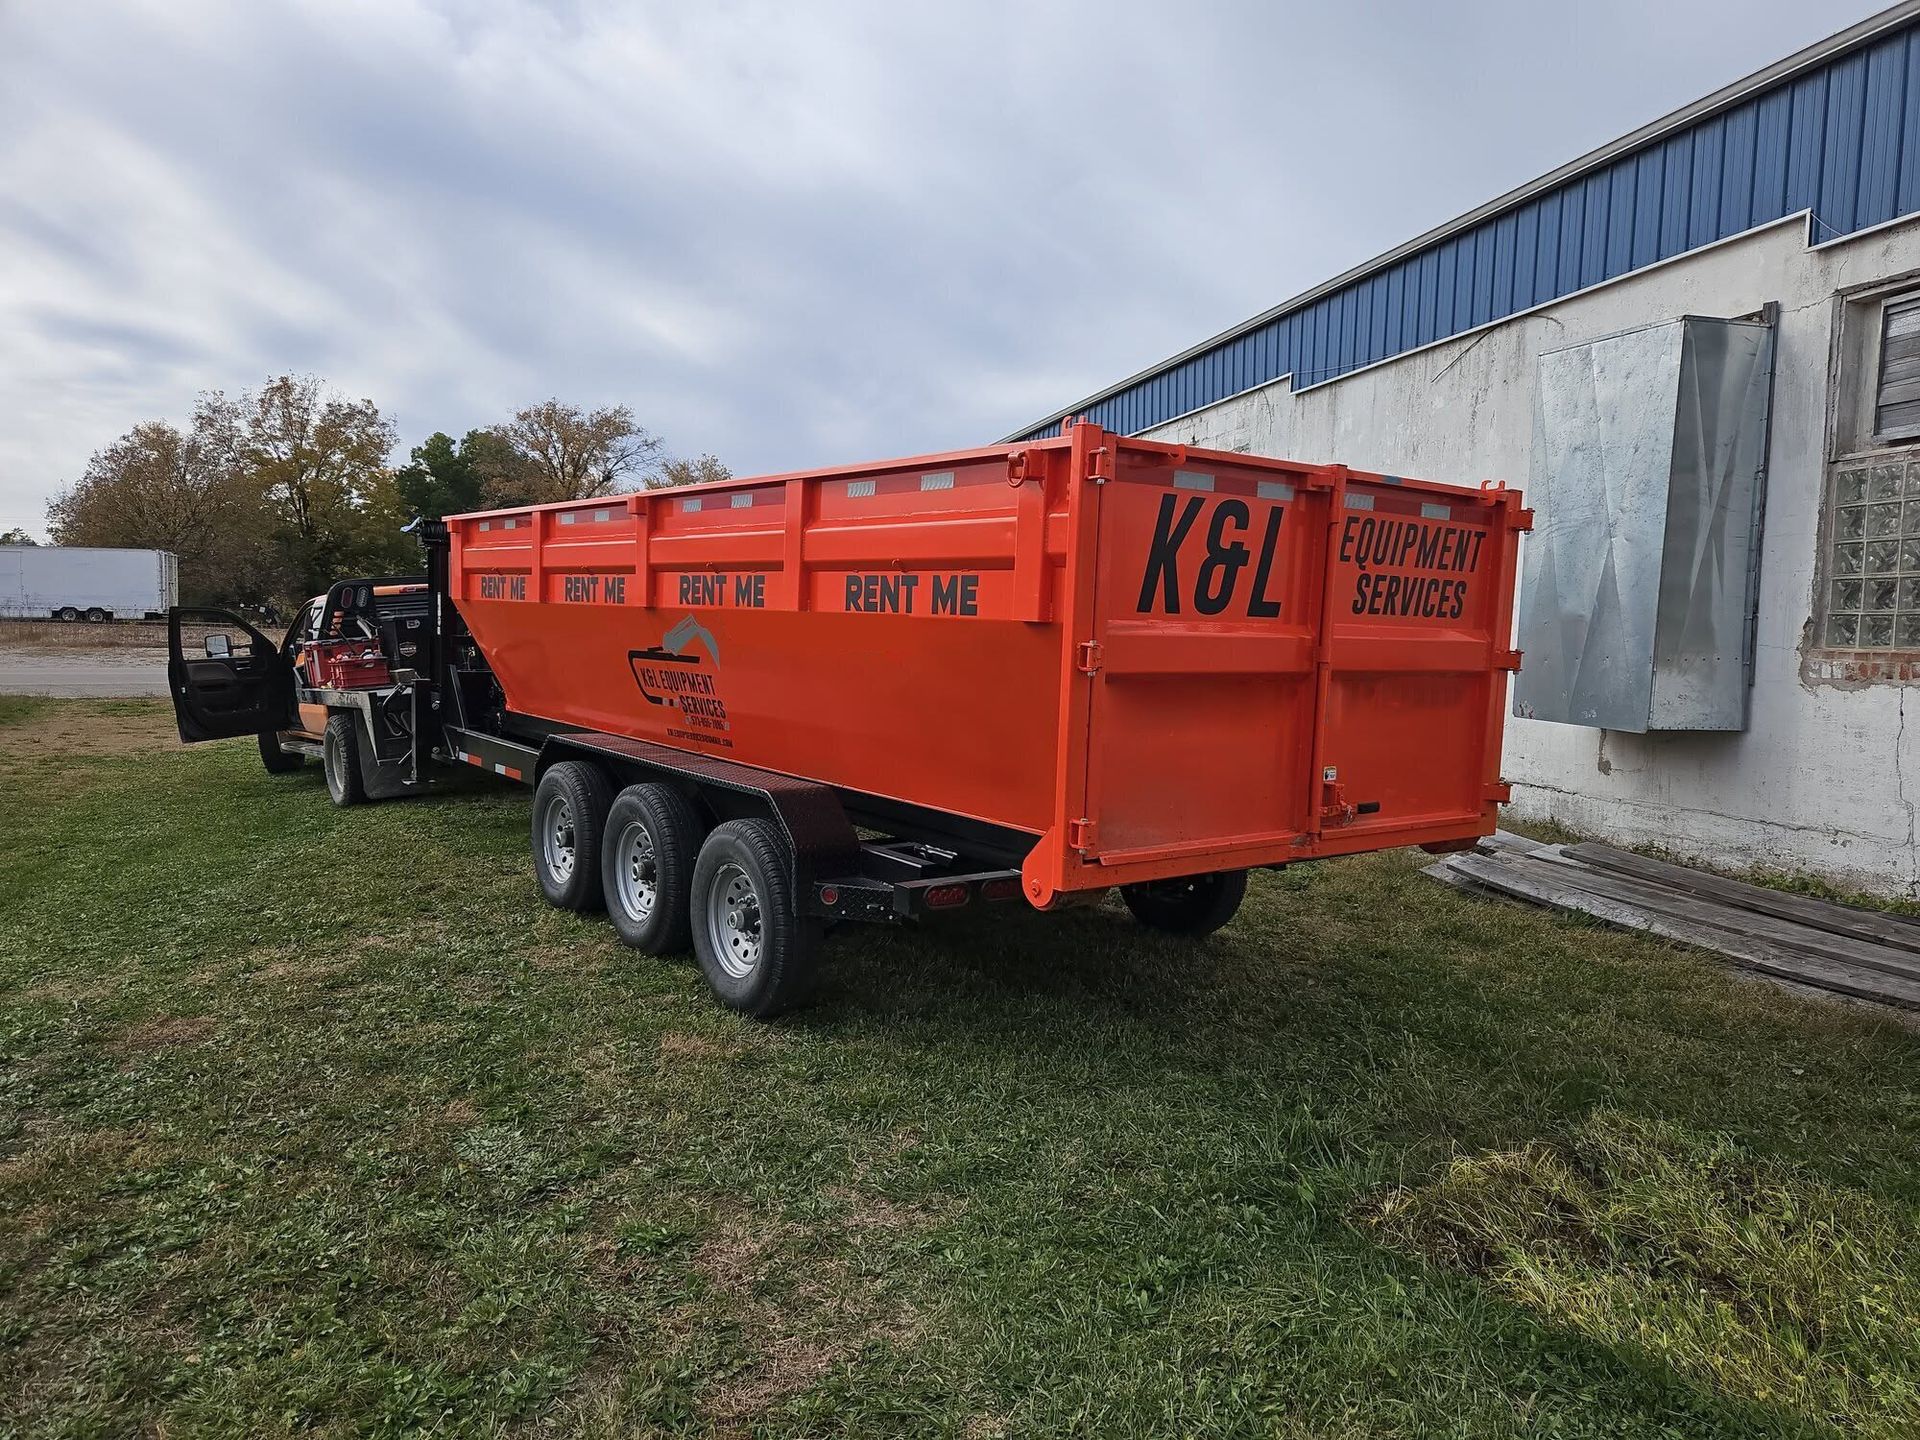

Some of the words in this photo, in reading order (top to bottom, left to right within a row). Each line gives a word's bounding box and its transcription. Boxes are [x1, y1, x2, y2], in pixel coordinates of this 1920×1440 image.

[1136, 493, 1284, 618] K&L
[1340, 516, 1487, 573] EQUIPMENT
[481, 576, 506, 599] RENT
[511, 577, 526, 600] ME
[565, 576, 598, 602] RENT
[605, 577, 625, 604] ME
[679, 575, 727, 606] RENT
[735, 575, 765, 608] ME
[845, 575, 918, 613] RENT
[931, 575, 978, 616] ME
[1352, 574, 1468, 619] SERVICES
[640, 668, 660, 688] K&L
[660, 670, 715, 696] EQUIPMENT
[679, 695, 726, 719] SERVICES
